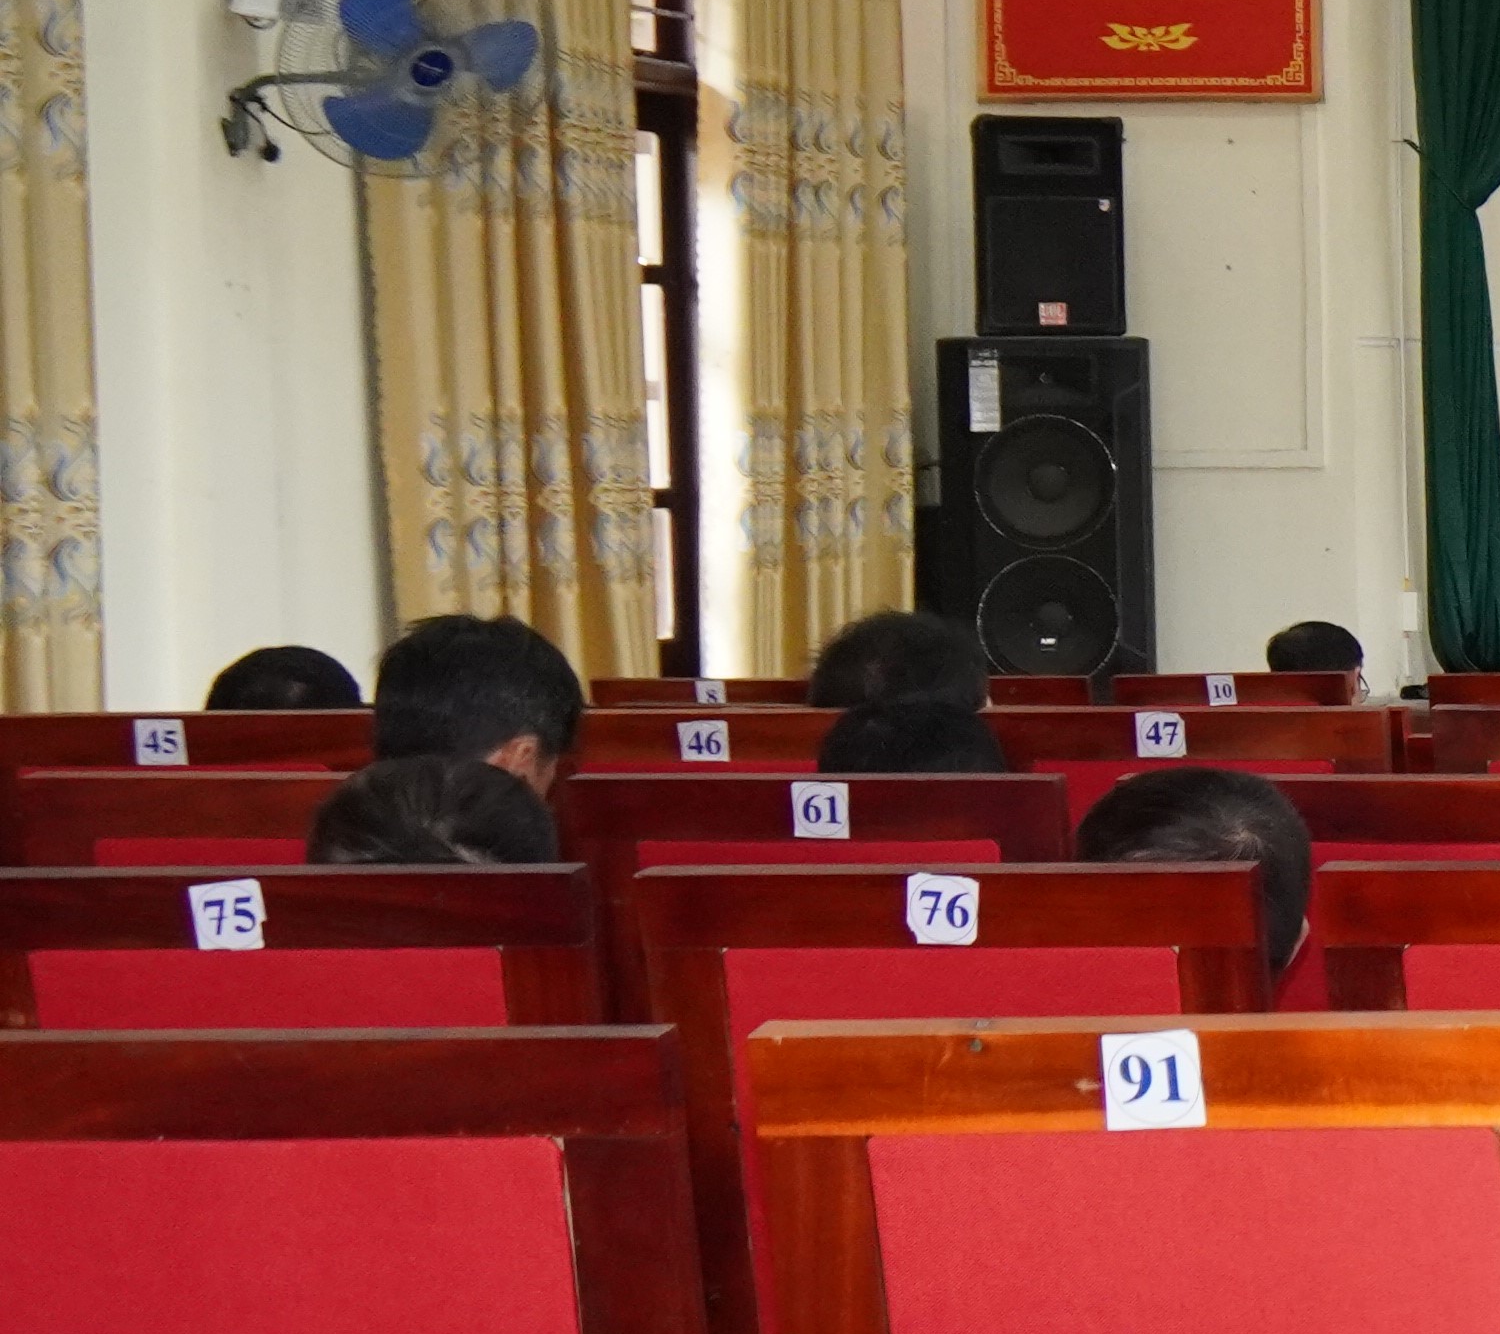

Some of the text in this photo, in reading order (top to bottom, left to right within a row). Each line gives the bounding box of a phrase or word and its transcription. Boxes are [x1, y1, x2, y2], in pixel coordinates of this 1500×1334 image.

[1212, 682, 1233, 700] 10
[143, 730, 178, 754] 45
[687, 730, 722, 755] 46
[1145, 721, 1179, 746] 47
[802, 795, 840, 824] 61
[203, 896, 256, 936] 75
[919, 889, 970, 929] 76
[1118, 1054, 1191, 1105] 91
